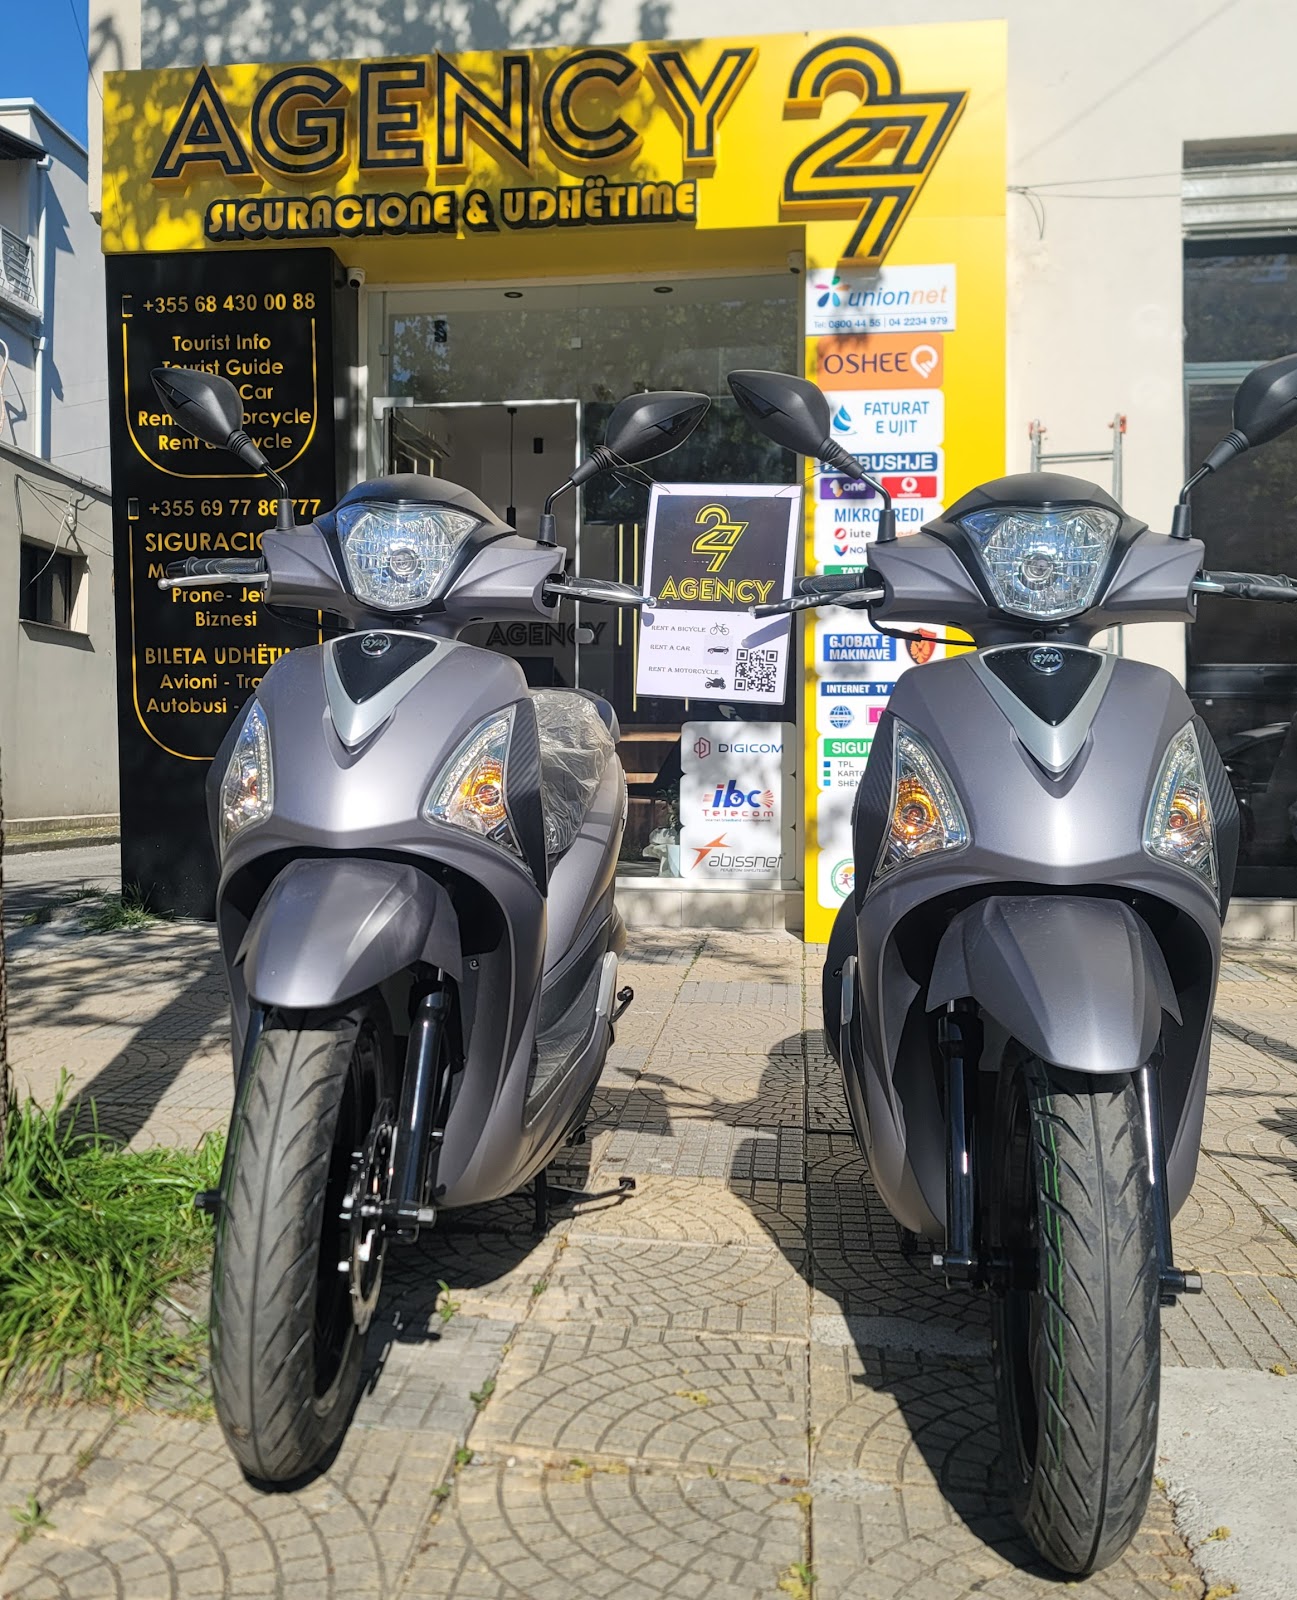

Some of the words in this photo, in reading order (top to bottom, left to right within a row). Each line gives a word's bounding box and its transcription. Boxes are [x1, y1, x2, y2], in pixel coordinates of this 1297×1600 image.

[151, 47, 758, 182] AGENCY
[779, 36, 966, 263] 27
[207, 192, 452, 236] SIGURACIONE
[464, 189, 492, 226] &
[501, 175, 696, 229] UDHËTIME
[143, 297, 189, 313] +355
[194, 295, 217, 312] 68
[223, 294, 257, 312] 430
[264, 293, 287, 311] 00
[293, 293, 316, 310] 88
[848, 287, 947, 308] unionnet
[855, 319, 867, 328] 44
[889, 318, 901, 327] 04
[903, 317, 927, 326] 2234
[930, 316, 948, 325] 979
[172, 335, 230, 352] Tourist
[236, 333, 271, 350] Info
[226, 359, 284, 375] Guide
[824, 352, 908, 375] OSHEE
[239, 384, 274, 400] Car
[864, 401, 930, 416] FATURAT
[138, 410, 177, 426] Ren
[242, 408, 312, 428] orcycle
[876, 421, 884, 434] E
[889, 420, 917, 436] UJIT
[158, 434, 199, 450] Rent
[251, 433, 293, 449] ycle
[843, 482, 866, 492] one
[149, 500, 195, 516] +355
[200, 500, 223, 516] 69
[229, 500, 251, 516] 77
[834, 508, 924, 523] MIKROREDI
[691, 503, 749, 573] 27
[849, 529, 871, 538] iute
[172, 586, 232, 603] Prone-
[658, 575, 776, 604] AGENCY
[195, 610, 257, 627] Biznesi
[362, 638, 388, 649] SYM
[829, 635, 878, 649] GJOBAT
[881, 635, 890, 648] E
[145, 647, 207, 665] BILETA
[829, 650, 890, 661] MAKINAVE
[1033, 653, 1061, 665] SYM
[160, 673, 217, 690] Avioni
[826, 684, 870, 694] INTERNET
[875, 684, 888, 694] TV
[146, 697, 227, 714] Autobusi
[718, 743, 784, 754] DIGICOM
[712, 779, 762, 808] ibc
[702, 809, 774, 817] Telecom
[708, 852, 783, 868] abissnet
